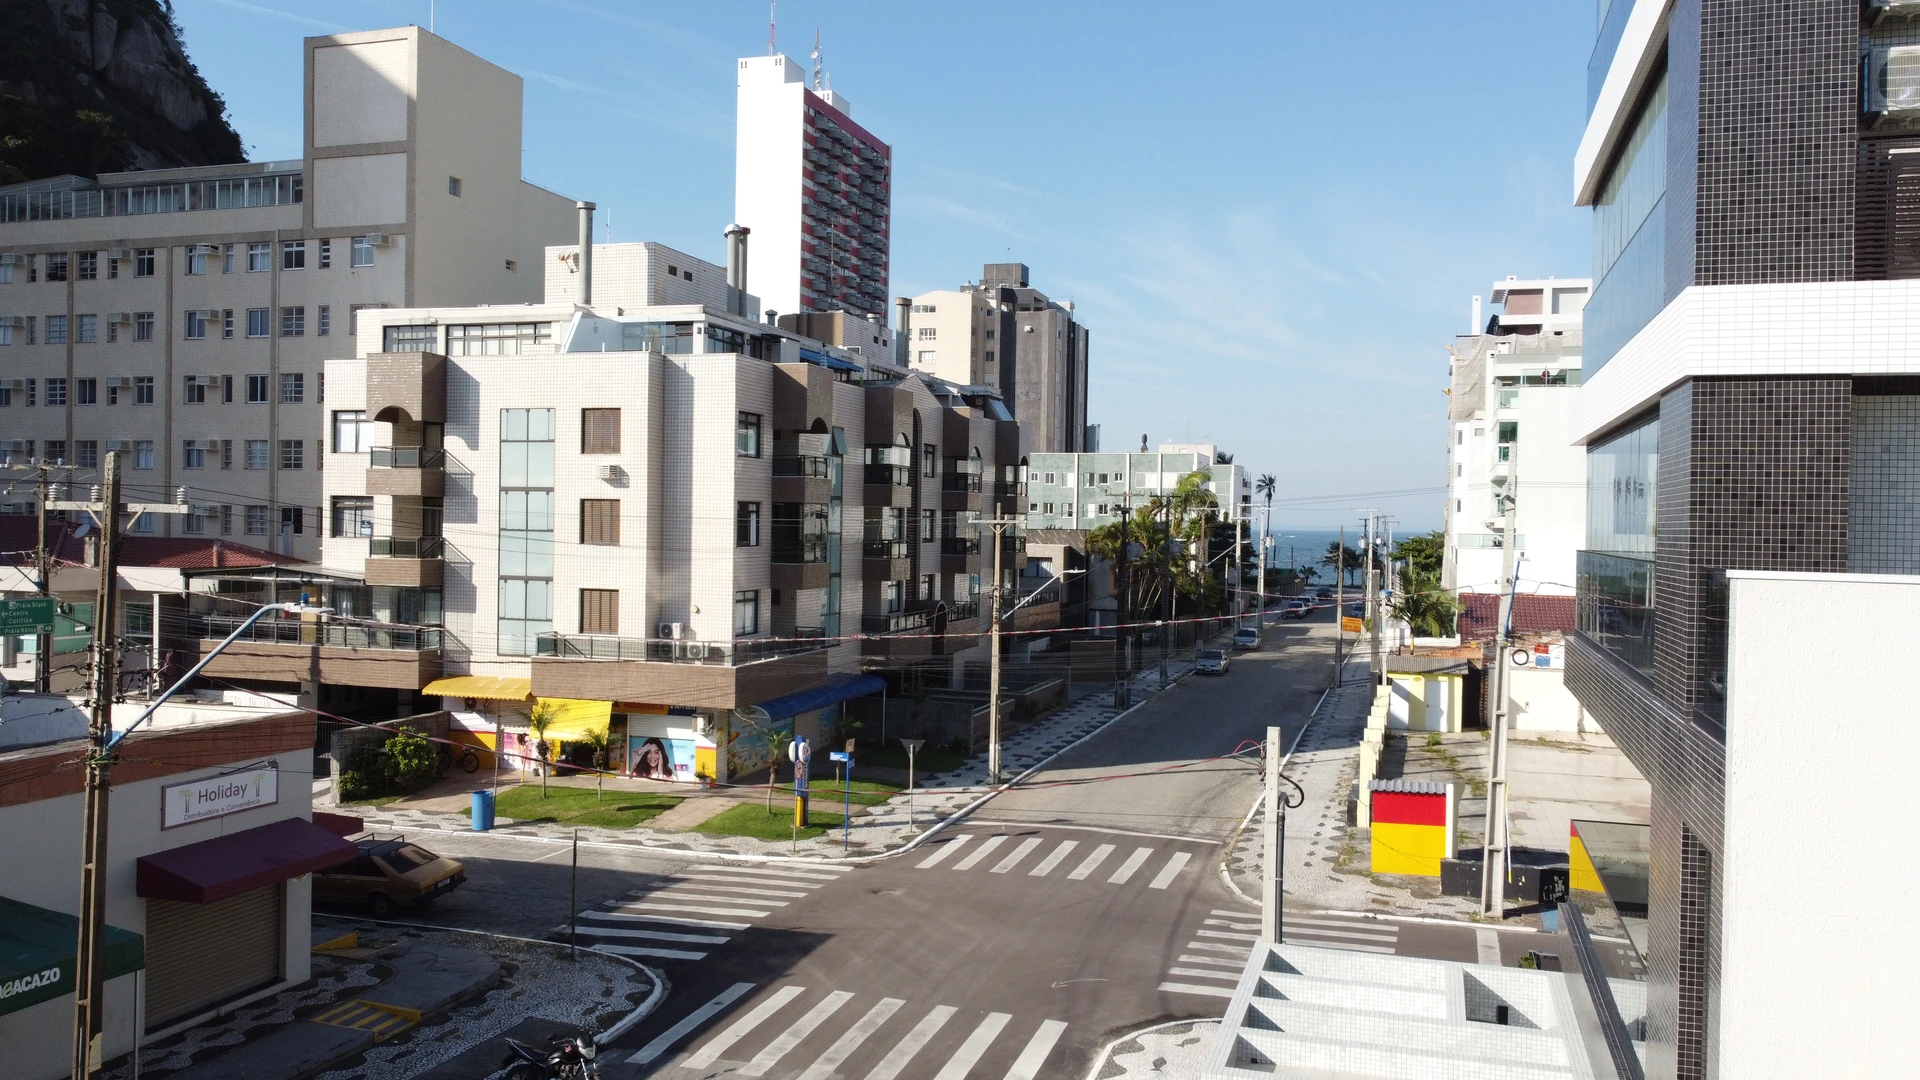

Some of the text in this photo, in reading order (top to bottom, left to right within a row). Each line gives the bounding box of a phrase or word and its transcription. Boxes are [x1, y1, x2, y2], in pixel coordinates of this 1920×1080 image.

[198, 782, 248, 804] Holiday
[184, 808, 219, 820] Distribuidora
[226, 799, 260, 811] Conveniência
